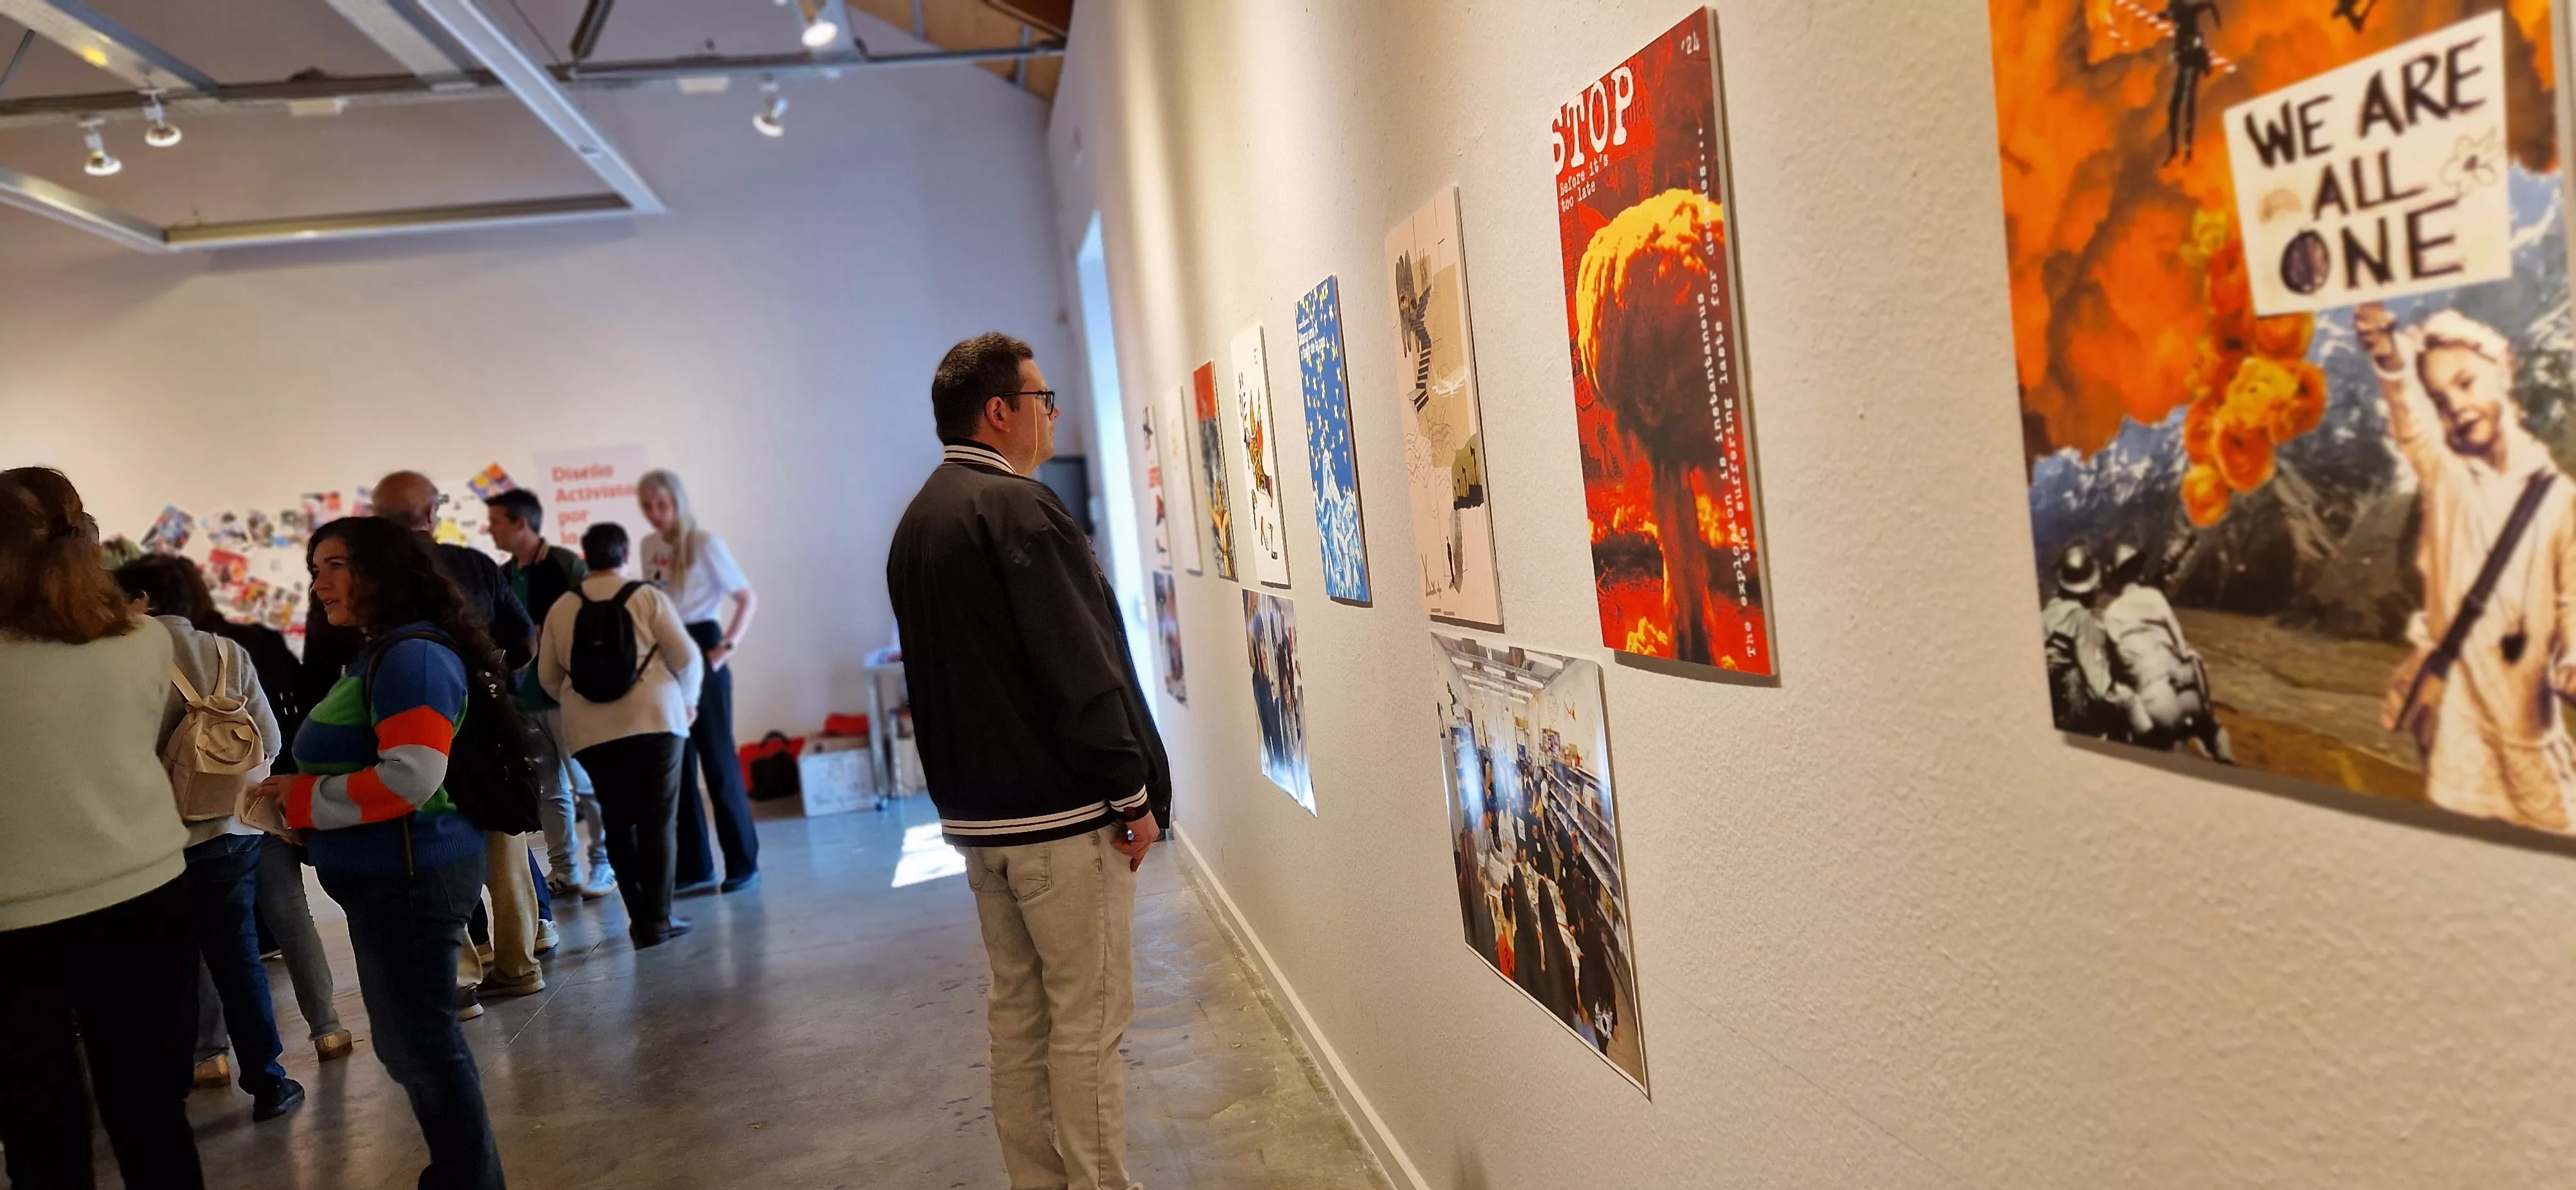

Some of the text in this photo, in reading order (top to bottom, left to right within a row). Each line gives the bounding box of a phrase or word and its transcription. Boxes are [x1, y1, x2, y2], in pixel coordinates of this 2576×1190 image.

[1681, 31, 1700, 54] '24
[1551, 66, 1634, 176] STOP
[2244, 35, 2488, 169] WE ARE
[1559, 154, 1609, 197] Before it's
[1561, 180, 1596, 213] too late
[2313, 147, 2430, 222] ALL
[2280, 197, 2465, 296] ONE
[1709, 270, 1720, 307] for
[1715, 321, 1728, 384] lasts
[552, 463, 614, 483] Diseño
[1719, 456, 1729, 481] is
[1724, 397, 1745, 511] suffering
[1724, 493, 1748, 607] explosion
[1739, 527, 1751, 563] the
[1743, 621, 1757, 657] The
